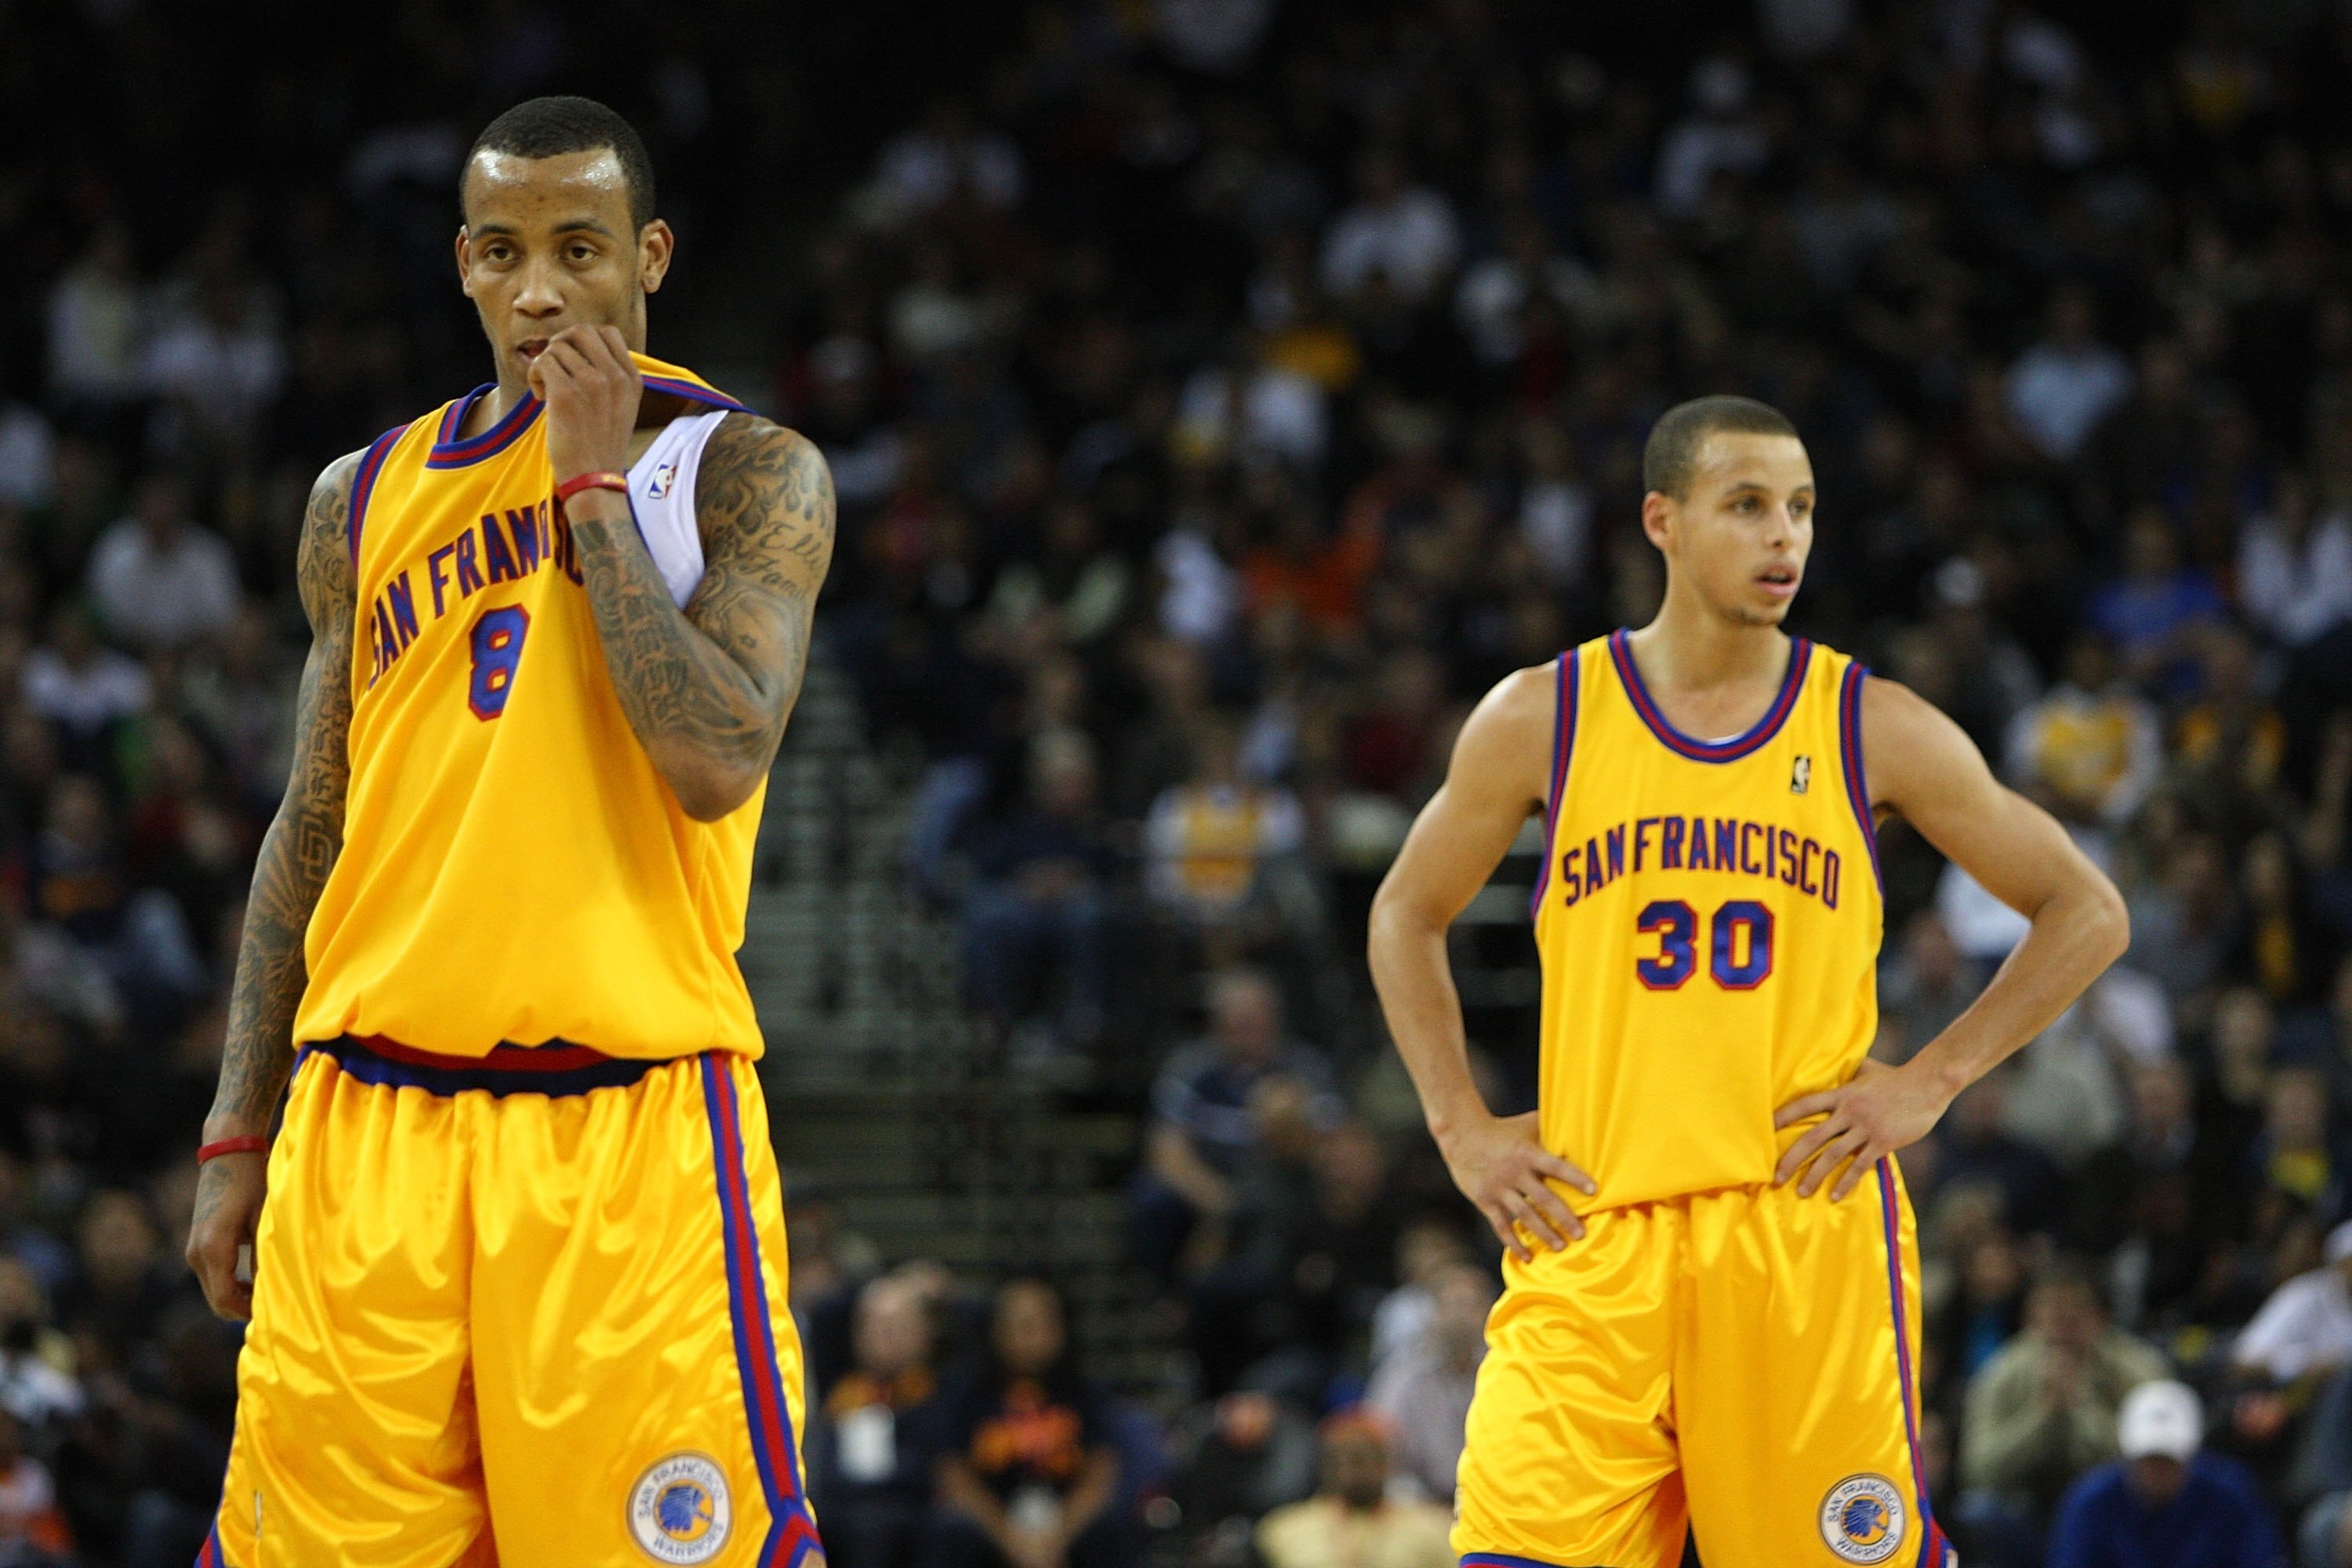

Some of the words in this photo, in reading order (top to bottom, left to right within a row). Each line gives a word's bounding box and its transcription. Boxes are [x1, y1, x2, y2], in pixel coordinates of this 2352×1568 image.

[368, 568, 419, 691] SAN
[468, 603, 531, 721] 8
[1563, 822, 1625, 907] SAN
[1633, 815, 1841, 910] FRANCISCO
[1636, 900, 1774, 990] 30
[638, 1486, 655, 1519] SAN
[1828, 1497, 1843, 1522] SAN
